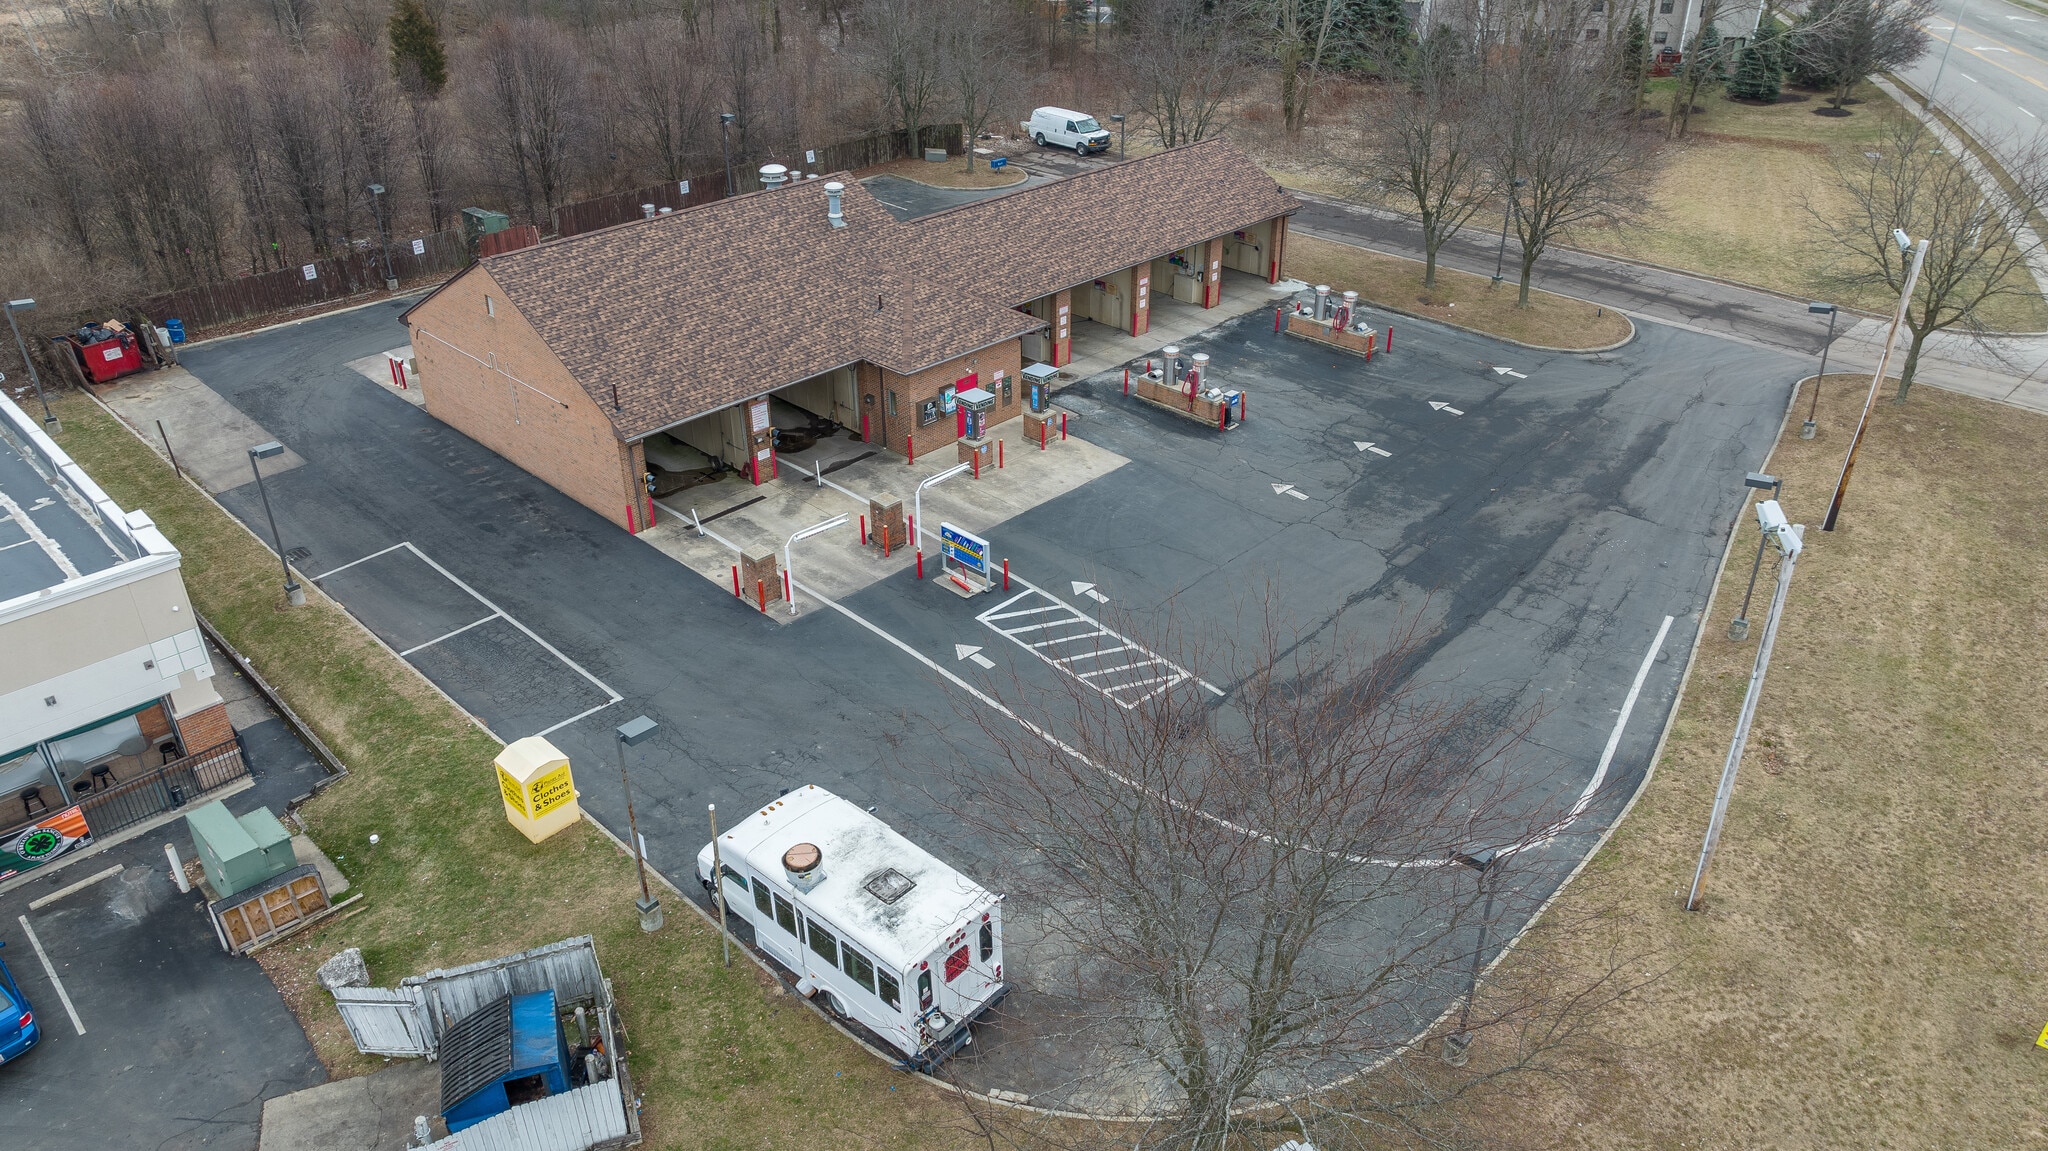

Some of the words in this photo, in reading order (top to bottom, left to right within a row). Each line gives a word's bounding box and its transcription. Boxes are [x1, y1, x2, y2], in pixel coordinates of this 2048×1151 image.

[532, 780, 569, 803] Clothes
[535, 803, 542, 812] &
[543, 789, 571, 807] Shoes
